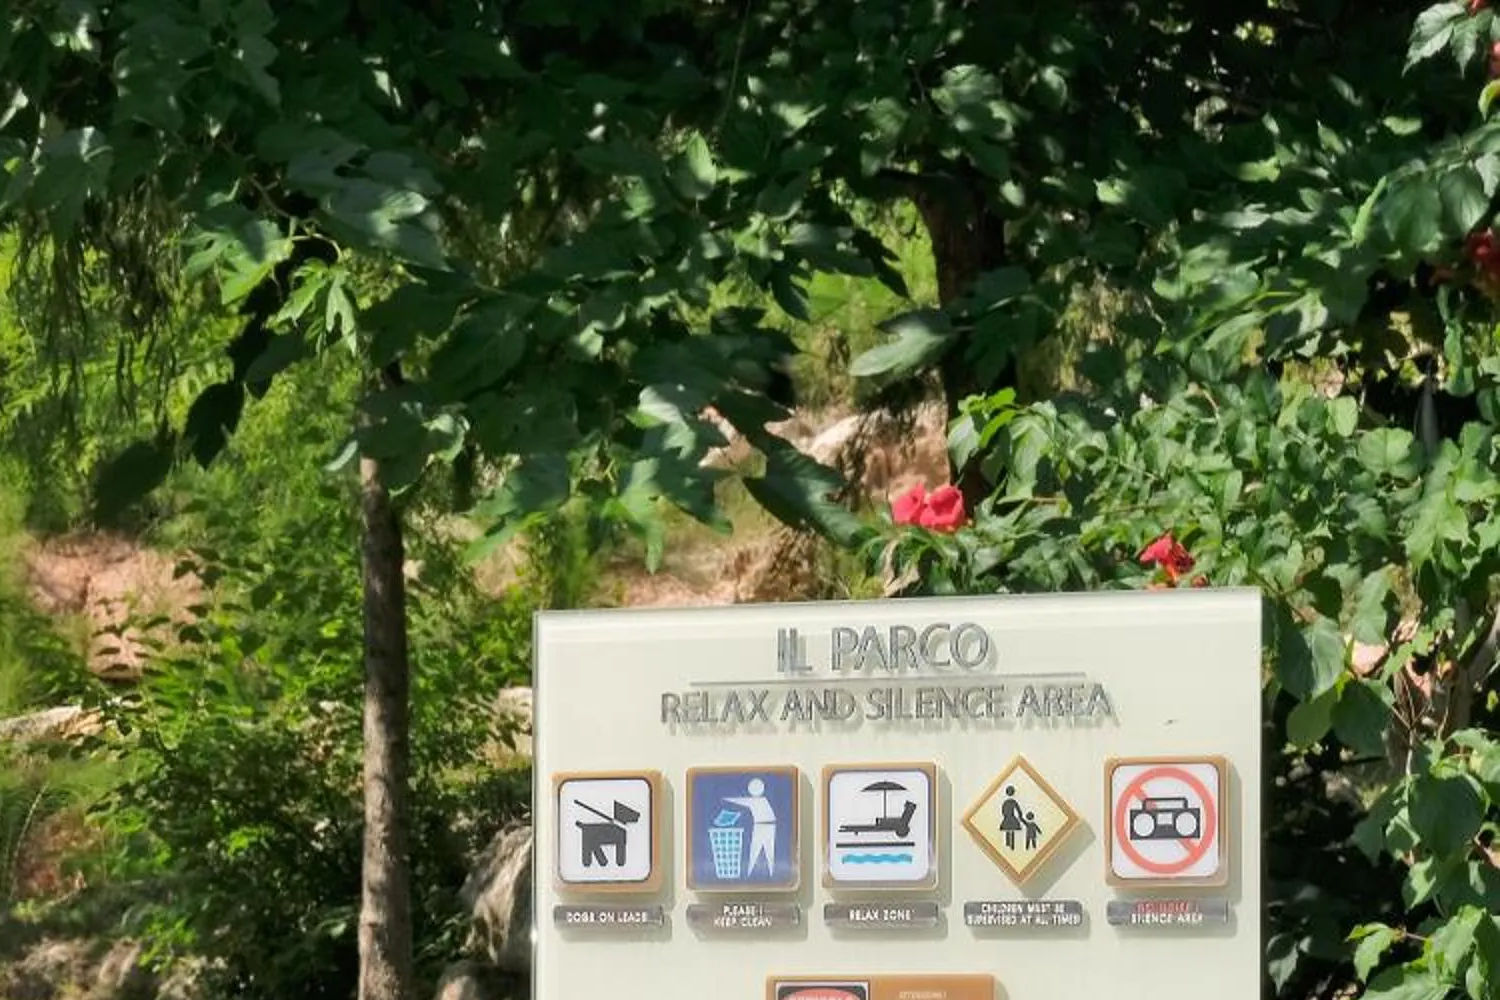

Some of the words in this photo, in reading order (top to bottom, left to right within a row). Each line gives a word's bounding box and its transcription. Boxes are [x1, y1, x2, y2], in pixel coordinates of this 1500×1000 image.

[777, 627, 812, 672] IL
[831, 622, 989, 670] PARCO
[660, 690, 769, 723] RELAX
[780, 688, 855, 721] AND
[865, 685, 1005, 720] SILENCE
[1016, 683, 1115, 717] AREA
[849, 909, 879, 921] RELAX
